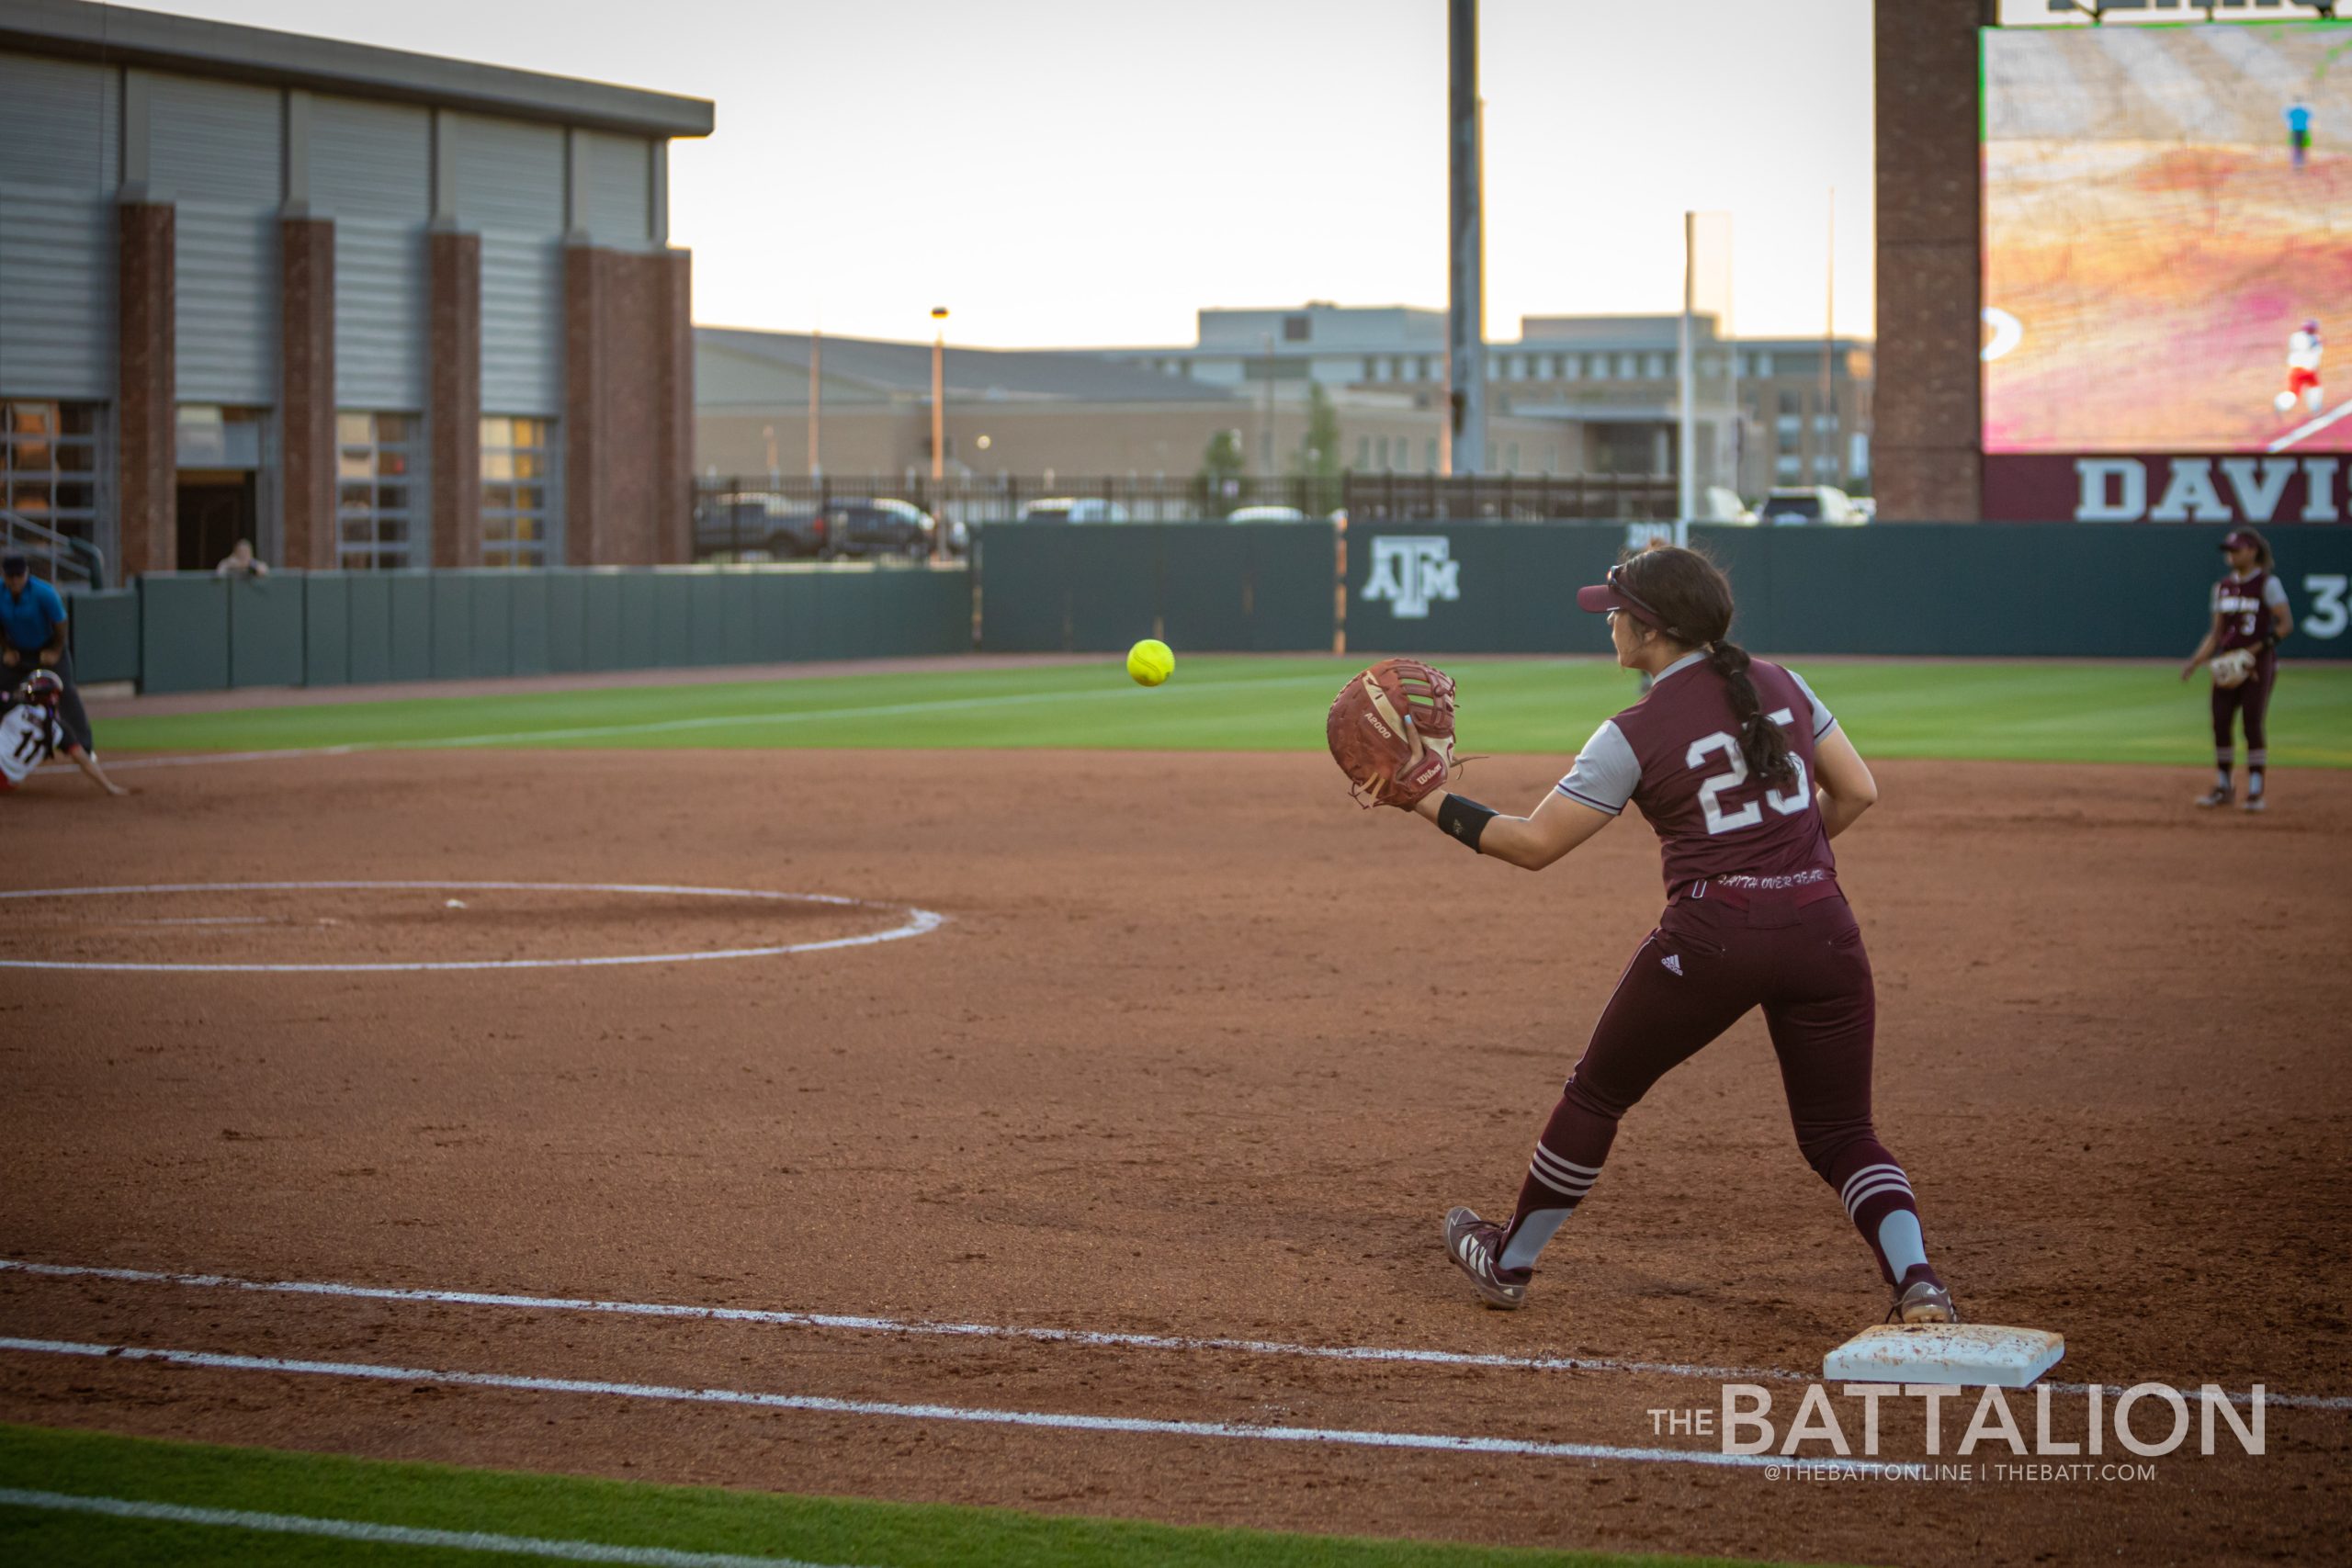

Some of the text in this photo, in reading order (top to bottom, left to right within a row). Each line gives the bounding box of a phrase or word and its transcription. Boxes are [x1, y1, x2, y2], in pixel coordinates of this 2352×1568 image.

[2074, 457, 2352, 522] DAVI
[2301, 573, 2352, 638] 3
[1364, 712, 1392, 739] A2000
[1416, 761, 1442, 785] Wilson
[1685, 707, 1810, 835] 25
[1761, 875, 1793, 889] OVER
